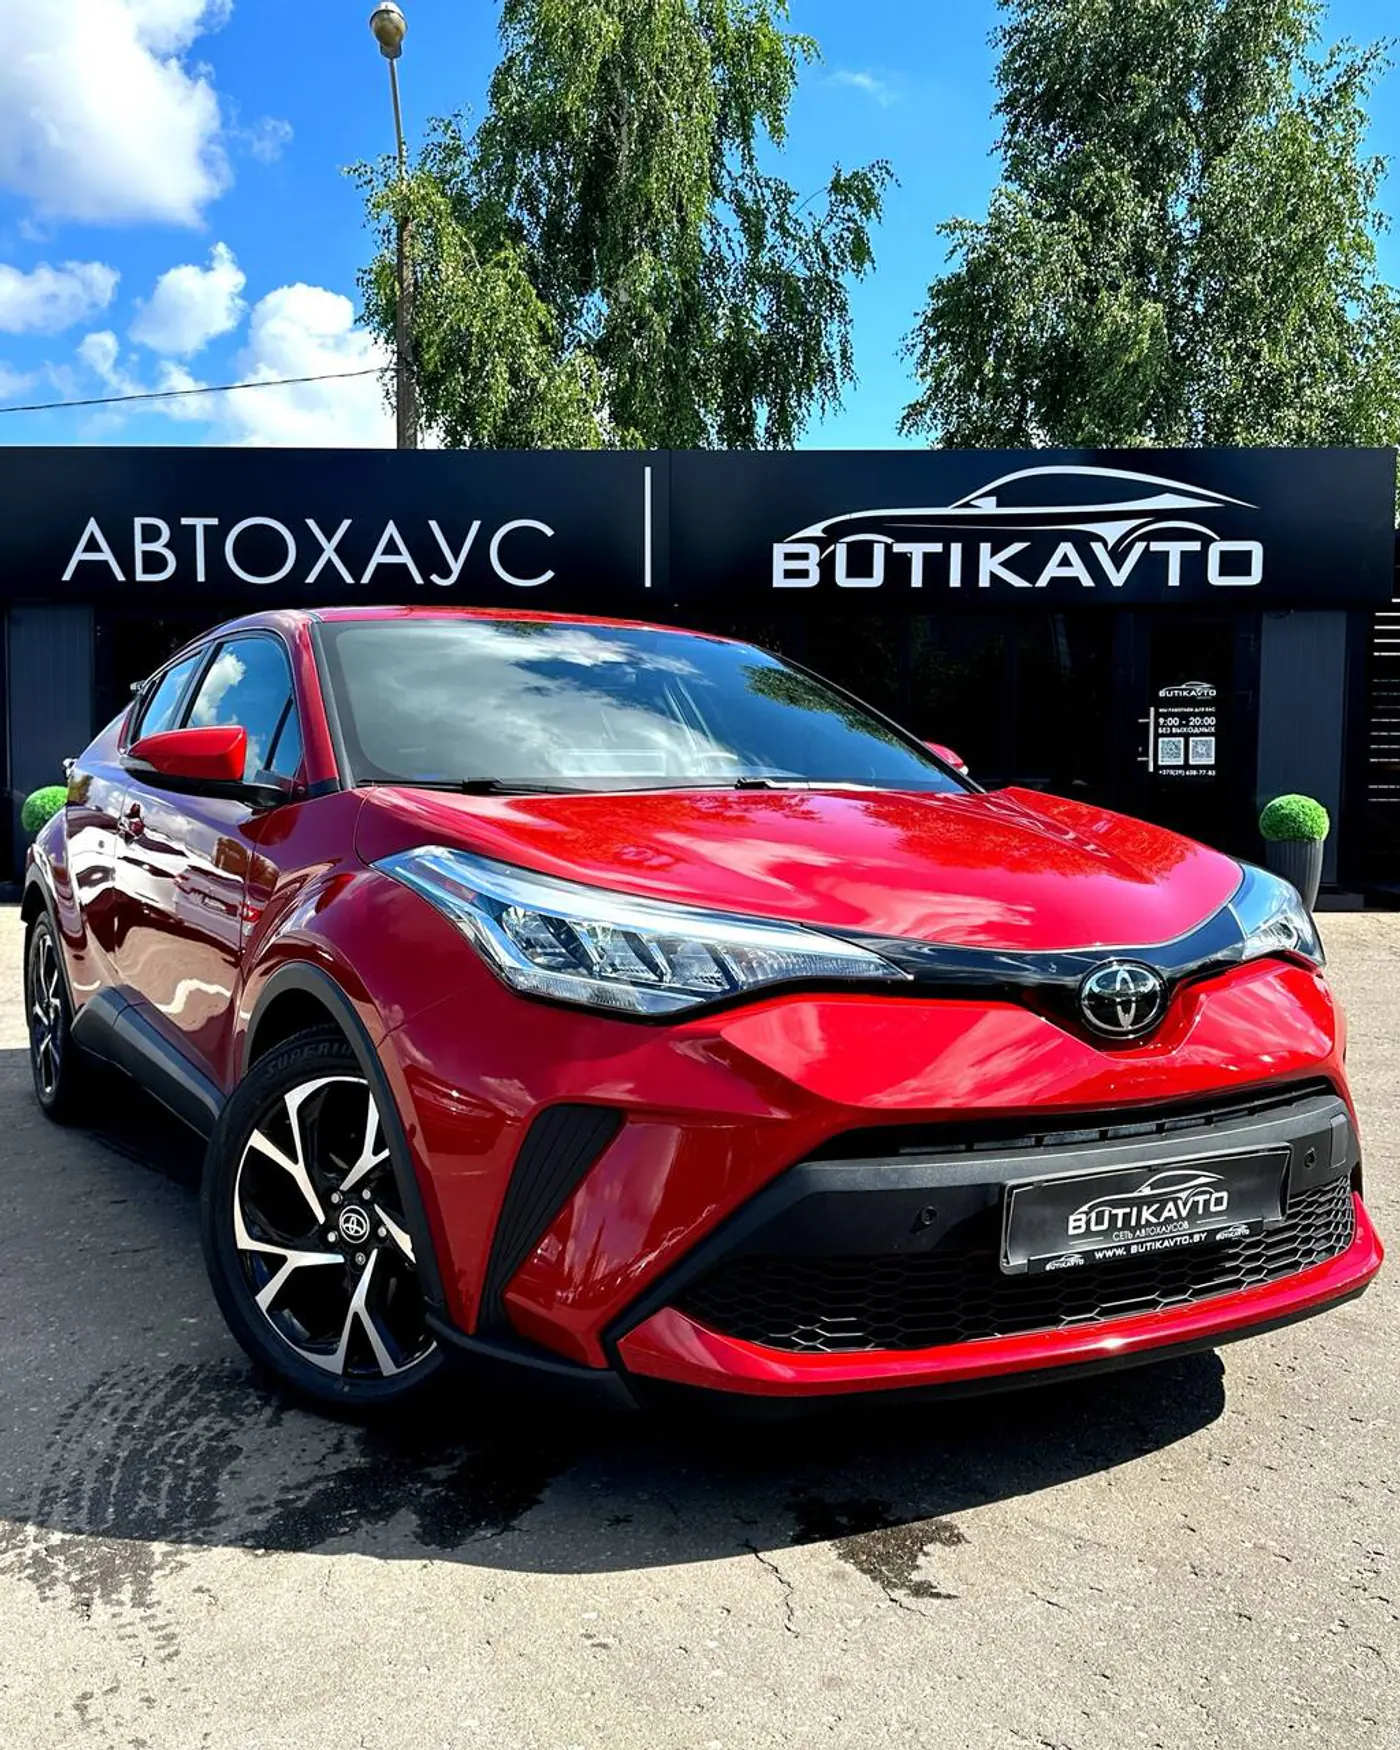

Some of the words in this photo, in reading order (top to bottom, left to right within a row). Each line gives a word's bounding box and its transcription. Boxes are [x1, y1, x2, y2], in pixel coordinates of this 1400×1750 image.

[61, 516, 556, 587] АВТОХАУС
[772, 540, 1264, 588] BUTIKAVTO
[1158, 717, 1180, 726] 9:00
[1189, 716, 1216, 726] 20:00
[1172, 726, 1216, 734] ВЫХОДНЫХ
[1067, 1191, 1228, 1236] BUTIKAVTO
[1093, 1246, 1127, 1260] WWW.
[1130, 1232, 1207, 1254] BUTIKAVTO.BY
[1112, 1230, 1133, 1242] СЕТЬ
[1135, 1222, 1190, 1238] АВТОХАУСОВ
